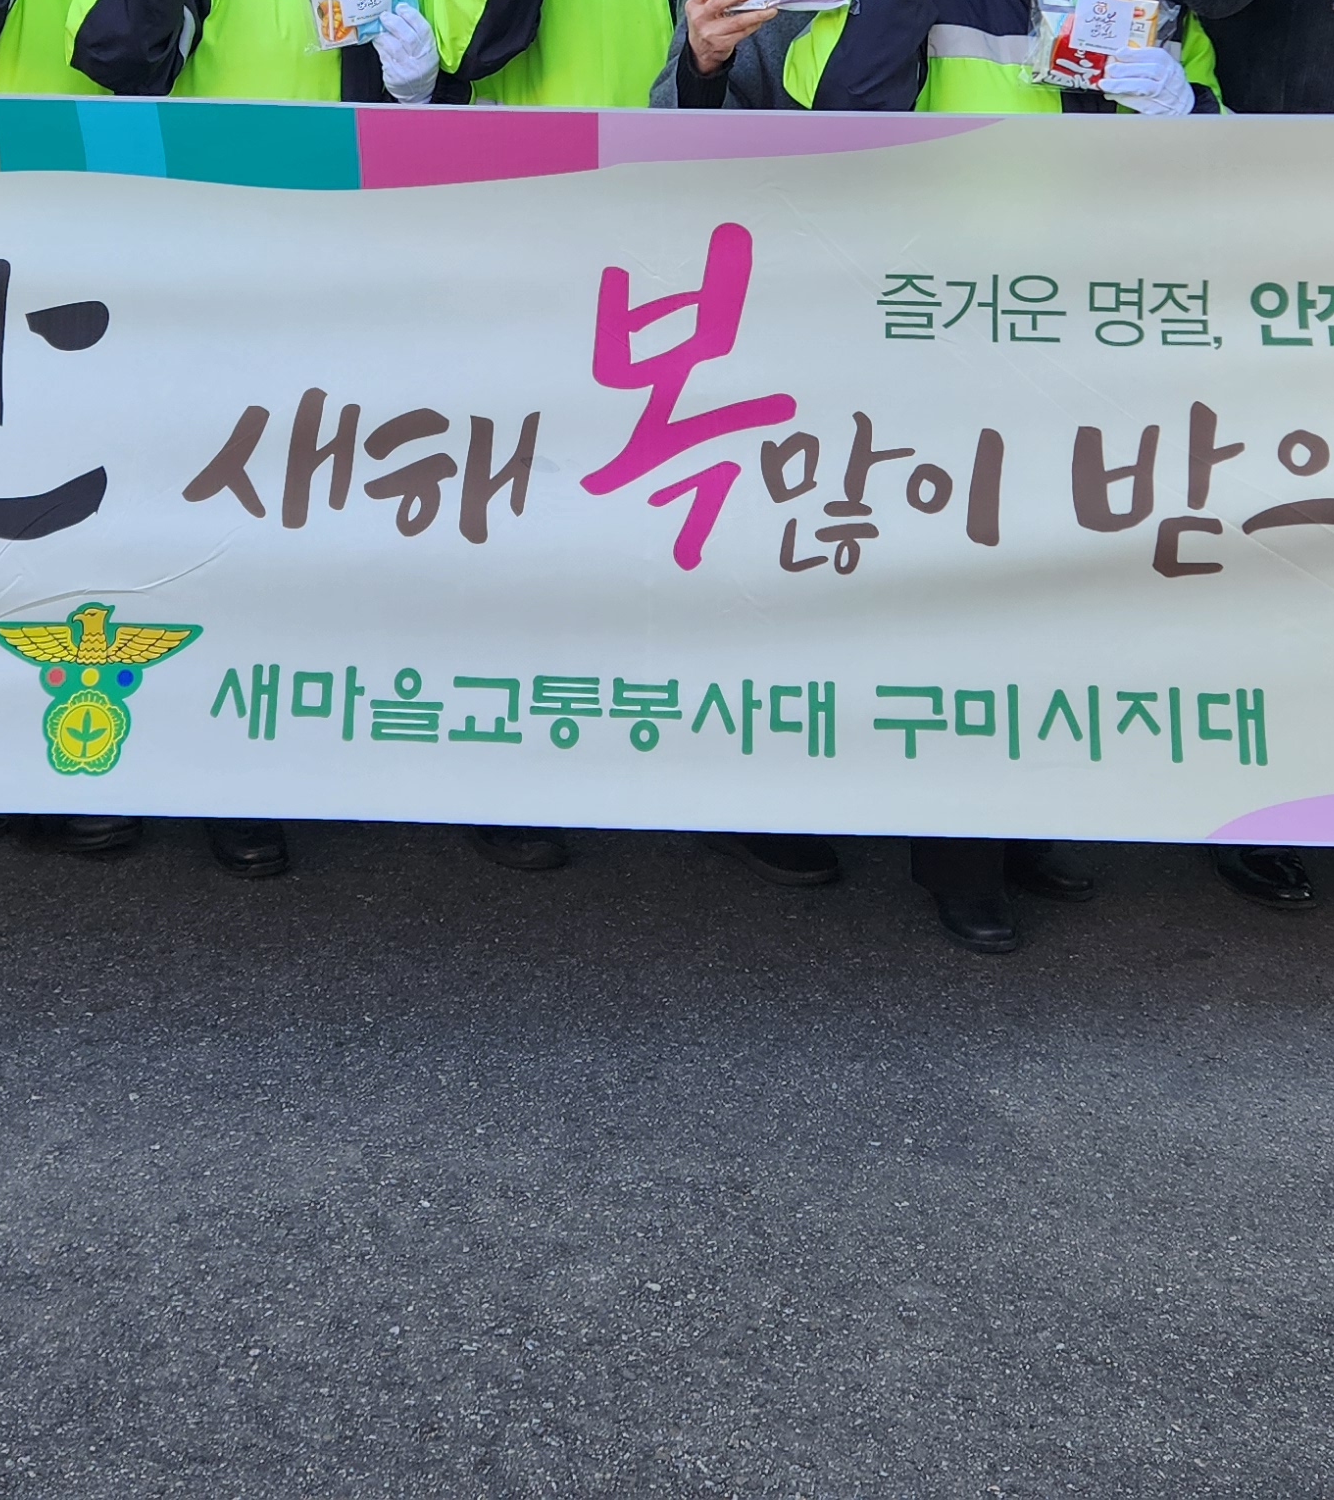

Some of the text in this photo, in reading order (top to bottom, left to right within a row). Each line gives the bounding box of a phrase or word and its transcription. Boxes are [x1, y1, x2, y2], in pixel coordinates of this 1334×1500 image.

[877, 274, 1066, 342] 즐거운
[1088, 278, 1223, 350] 명절,
[183, 388, 540, 544] 새해
[581, 223, 796, 570] 복
[761, 411, 1005, 576] 많이
[209, 663, 1268, 767] 새마을교통봉사대 구미시지대
